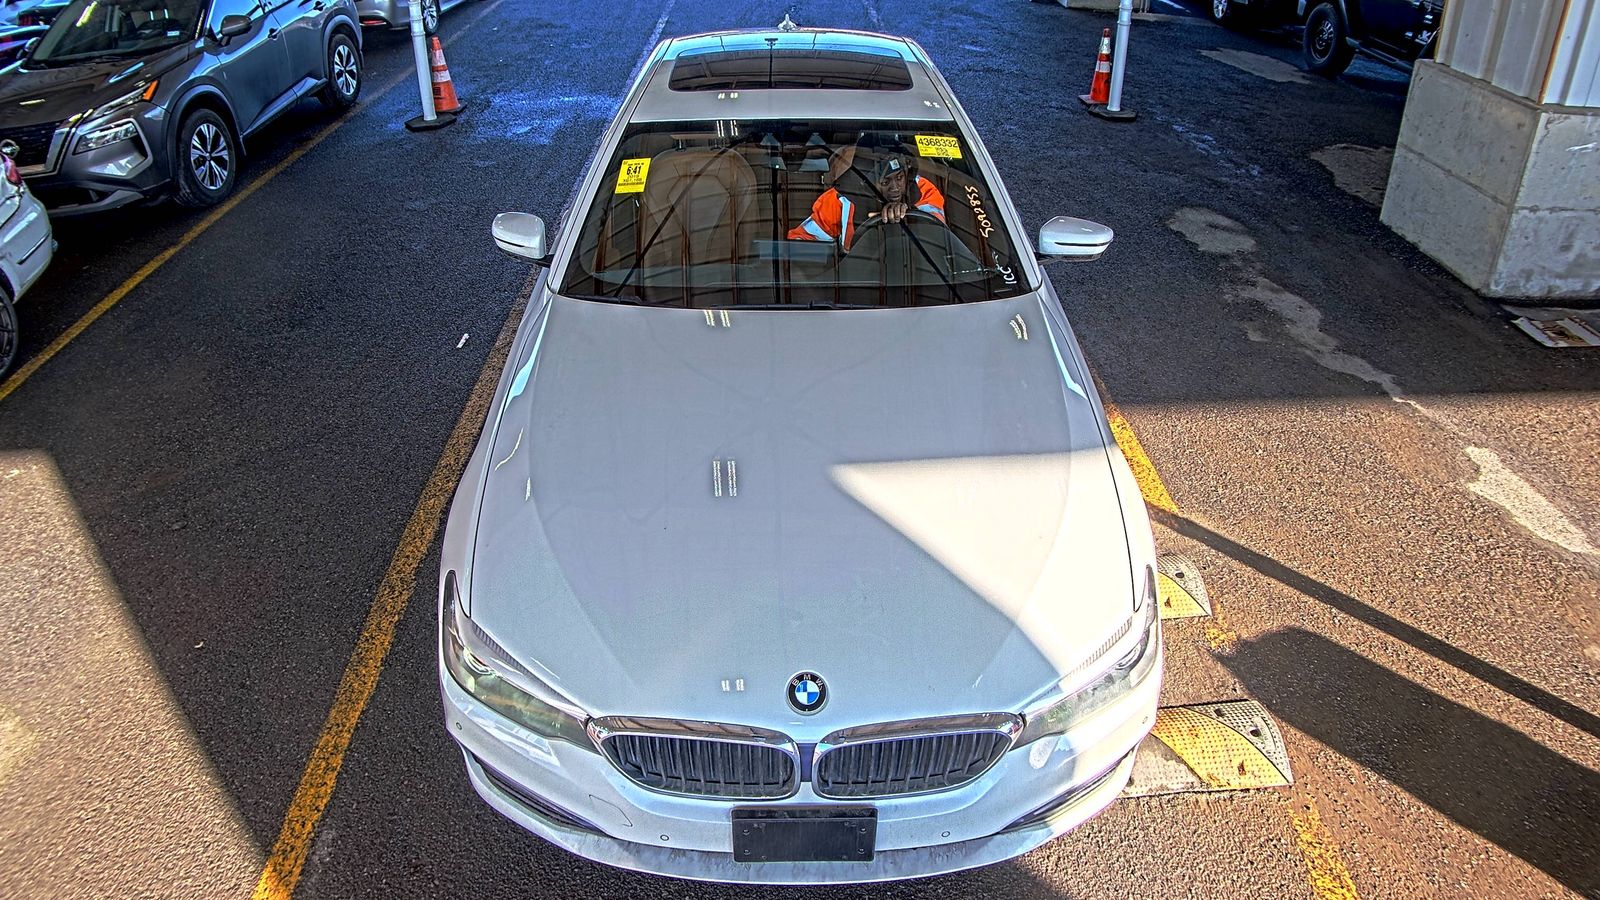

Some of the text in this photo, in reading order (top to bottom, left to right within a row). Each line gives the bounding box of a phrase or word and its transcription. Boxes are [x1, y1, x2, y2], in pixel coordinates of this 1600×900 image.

[918, 137, 957, 148] 4368332
[626, 165, 642, 175] 6:41
[791, 674, 823, 687] BMW
